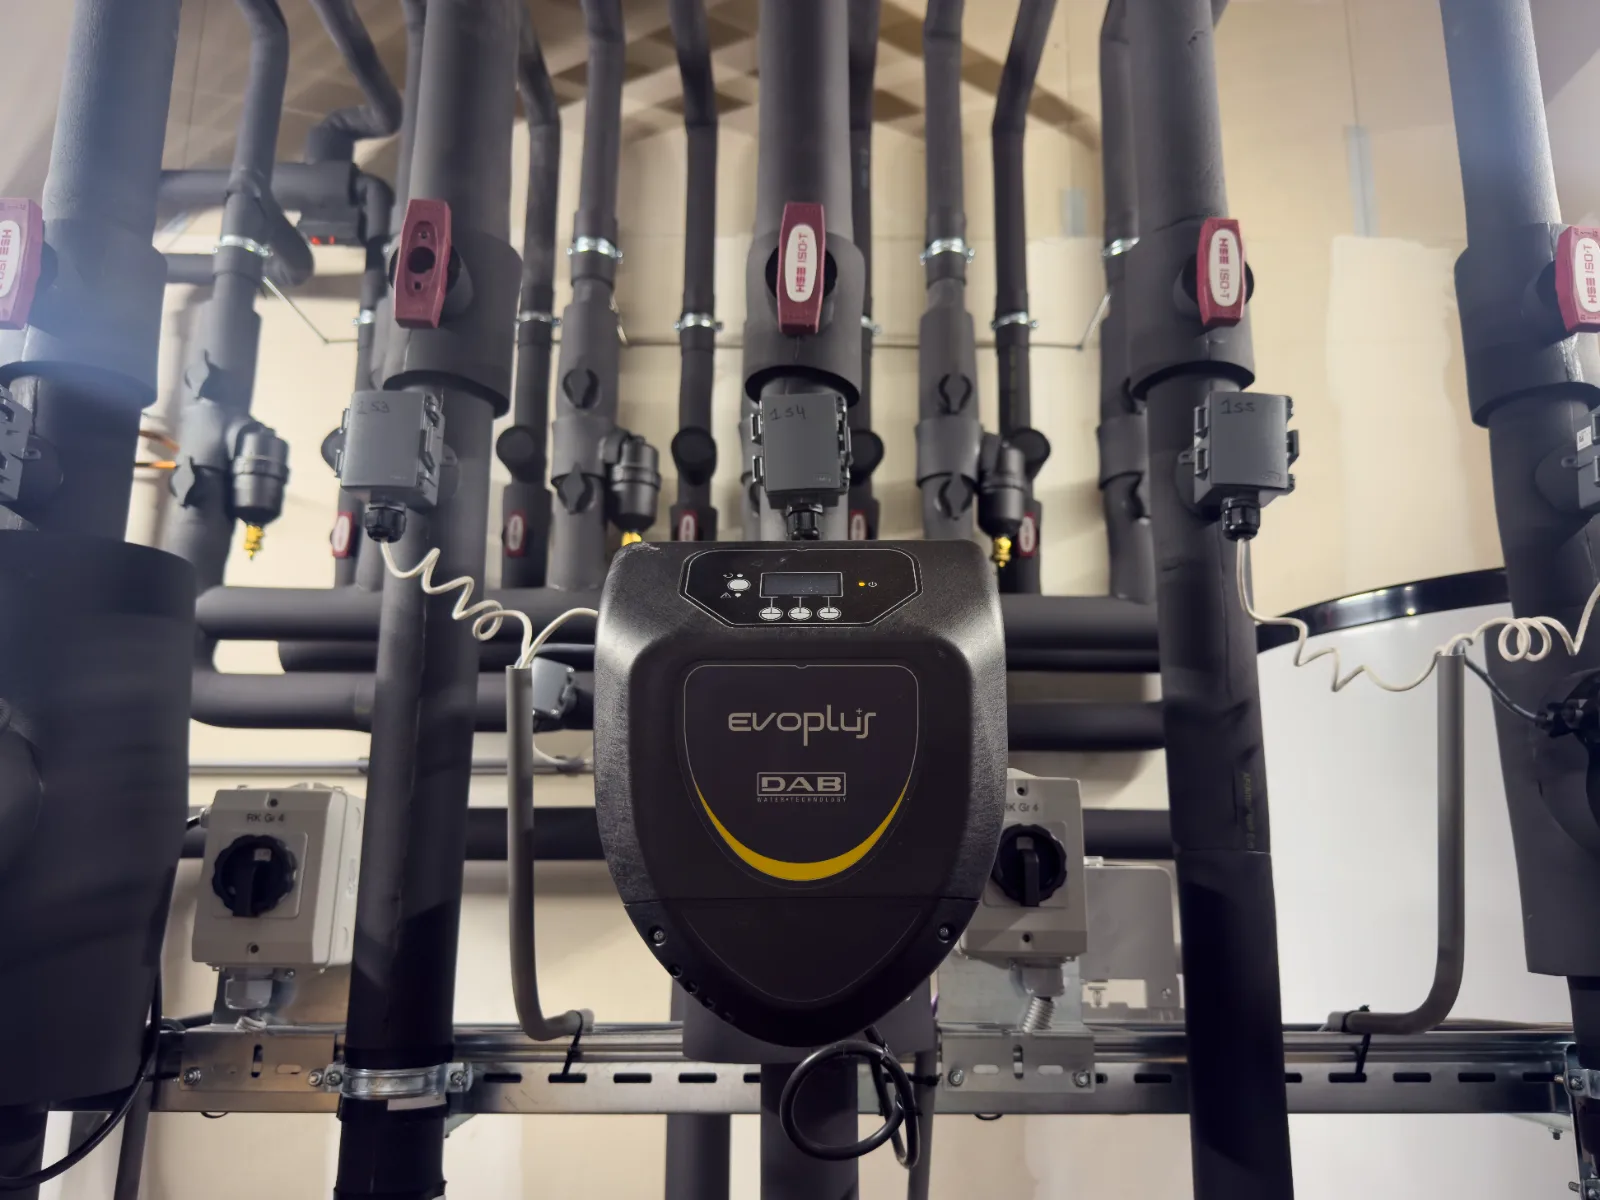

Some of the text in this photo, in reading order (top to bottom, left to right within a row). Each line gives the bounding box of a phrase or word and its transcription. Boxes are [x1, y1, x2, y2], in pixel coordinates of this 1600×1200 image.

[761, 776, 842, 792] DAB
[1019, 802, 1030, 812] Gr
[1032, 803, 1039, 812] 4
[246, 813, 261, 823] RK
[277, 813, 285, 823] 4
